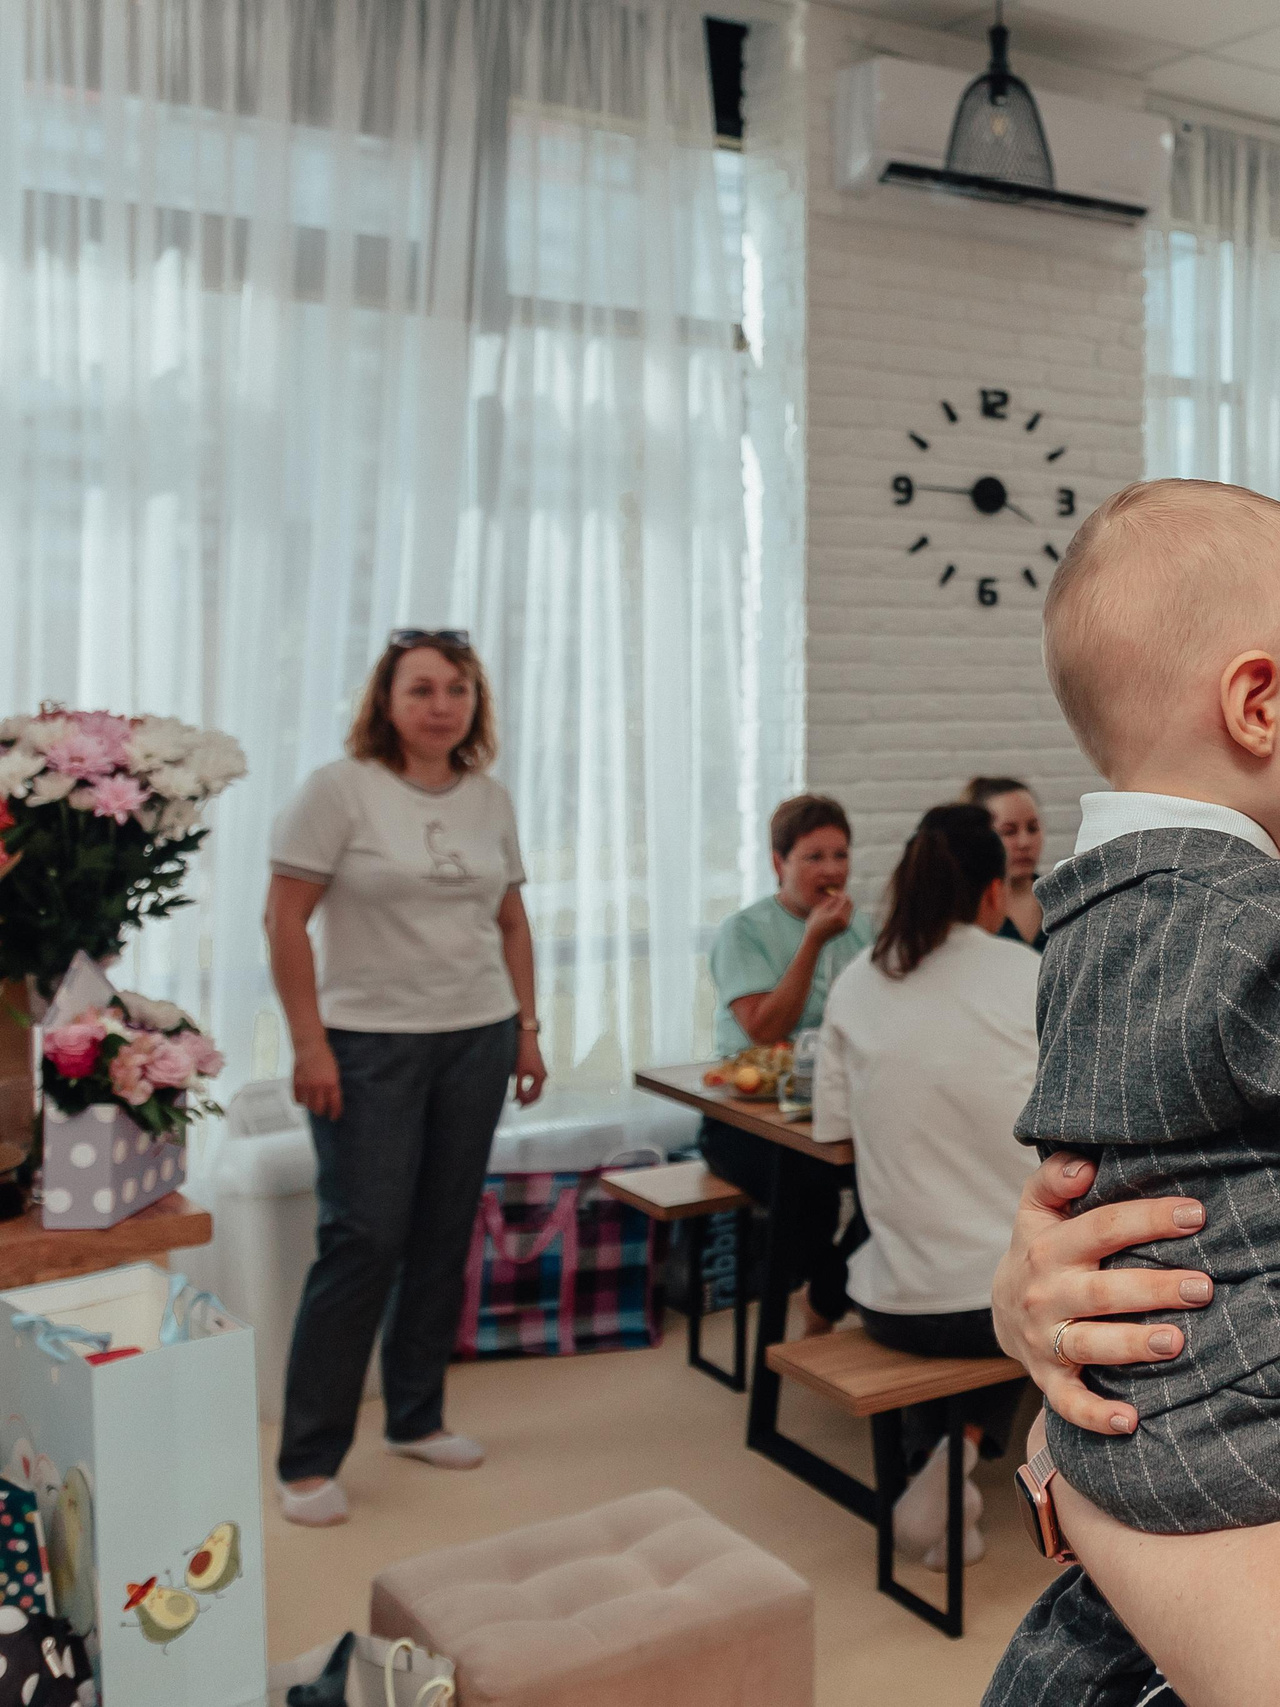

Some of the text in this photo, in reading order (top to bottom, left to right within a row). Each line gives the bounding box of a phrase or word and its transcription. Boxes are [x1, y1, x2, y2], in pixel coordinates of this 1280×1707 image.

[893, 476, 914, 505] 9
[1057, 487, 1075, 517] 3
[977, 577, 998, 606] 6
